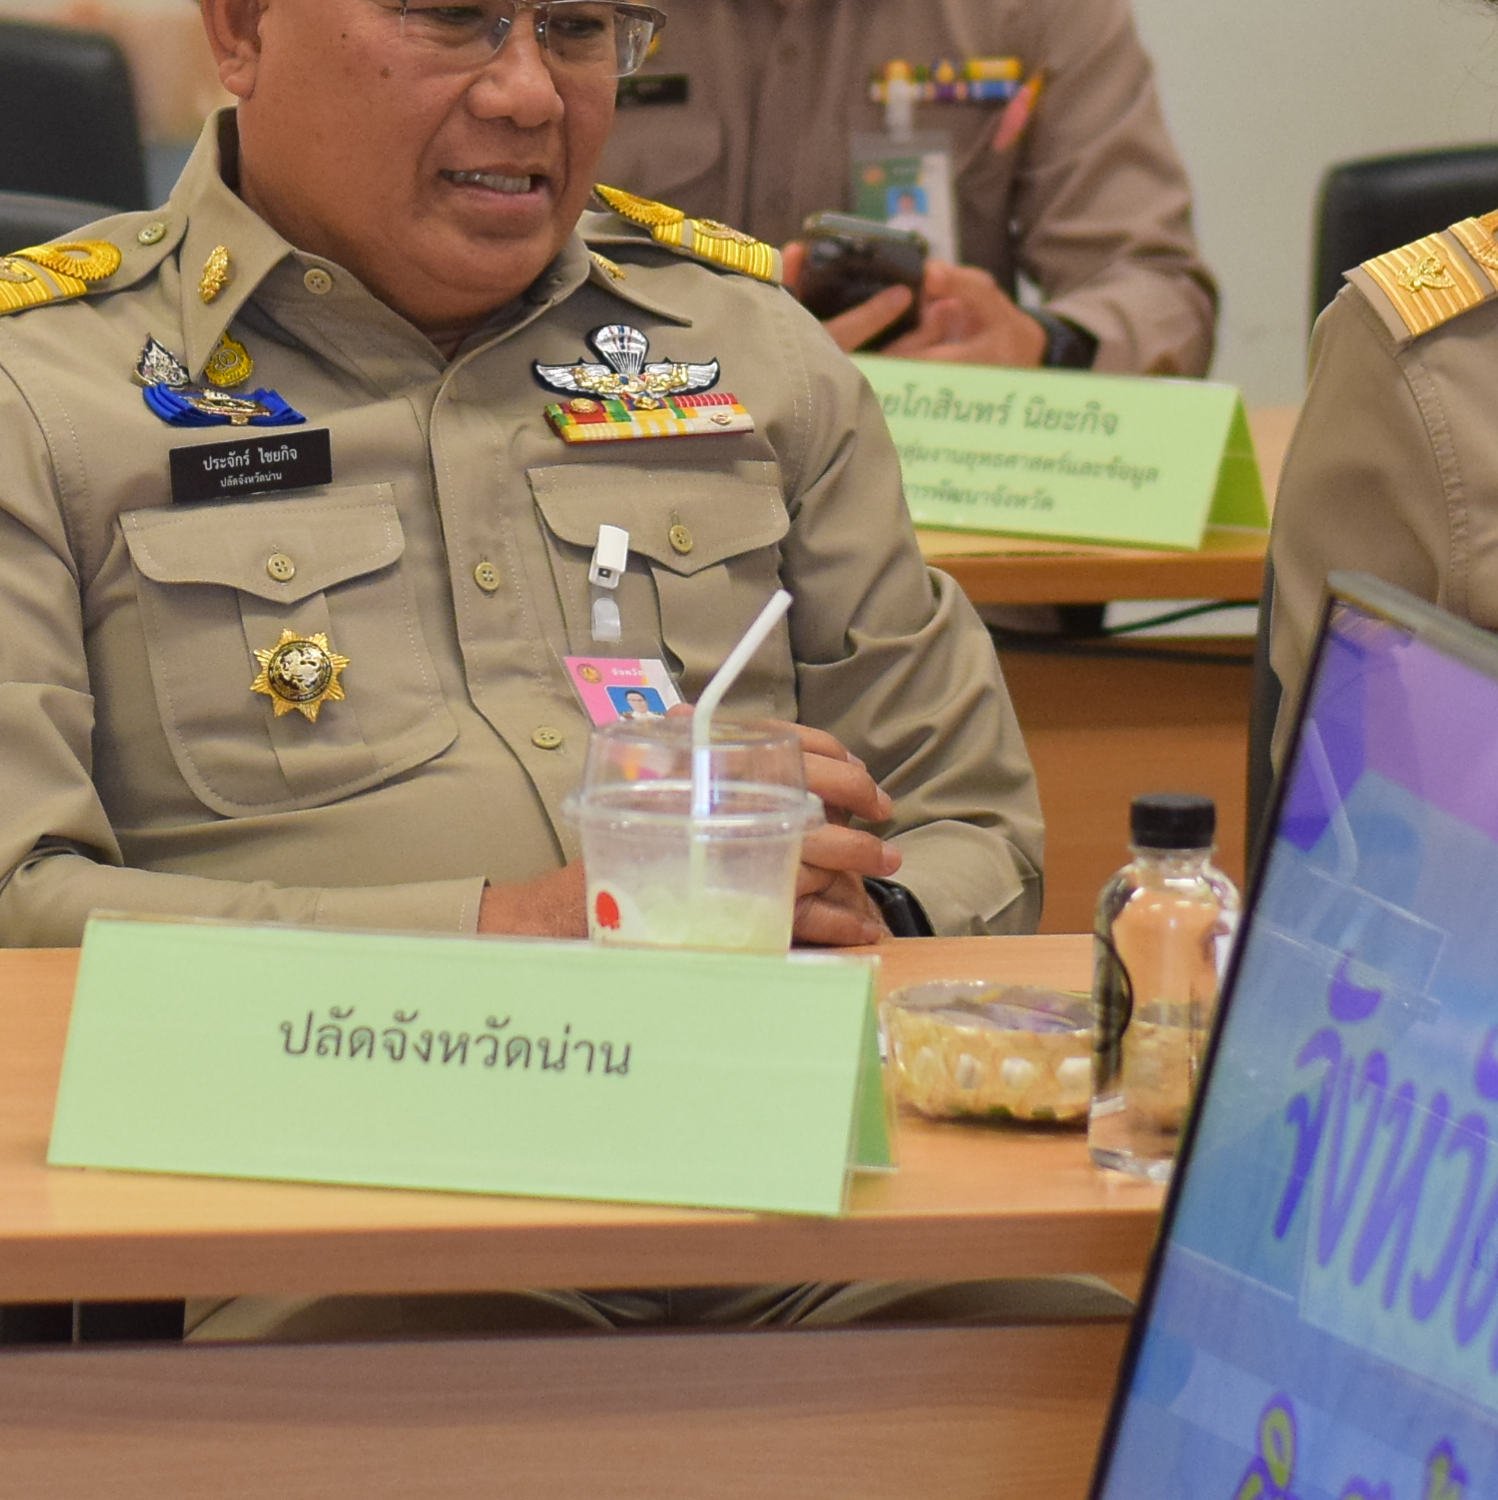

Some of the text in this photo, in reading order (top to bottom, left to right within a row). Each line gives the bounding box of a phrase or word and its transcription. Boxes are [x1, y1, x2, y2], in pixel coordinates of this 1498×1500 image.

[875, 382, 1018, 427] ยโกสินทร์
[203, 444, 298, 471] ประจักร์ ไชยกิจ
[220, 471, 282, 488] ปลัดจังหวัดน่าน
[279, 1005, 633, 1078] ปลัดจังหวัดน่าน
